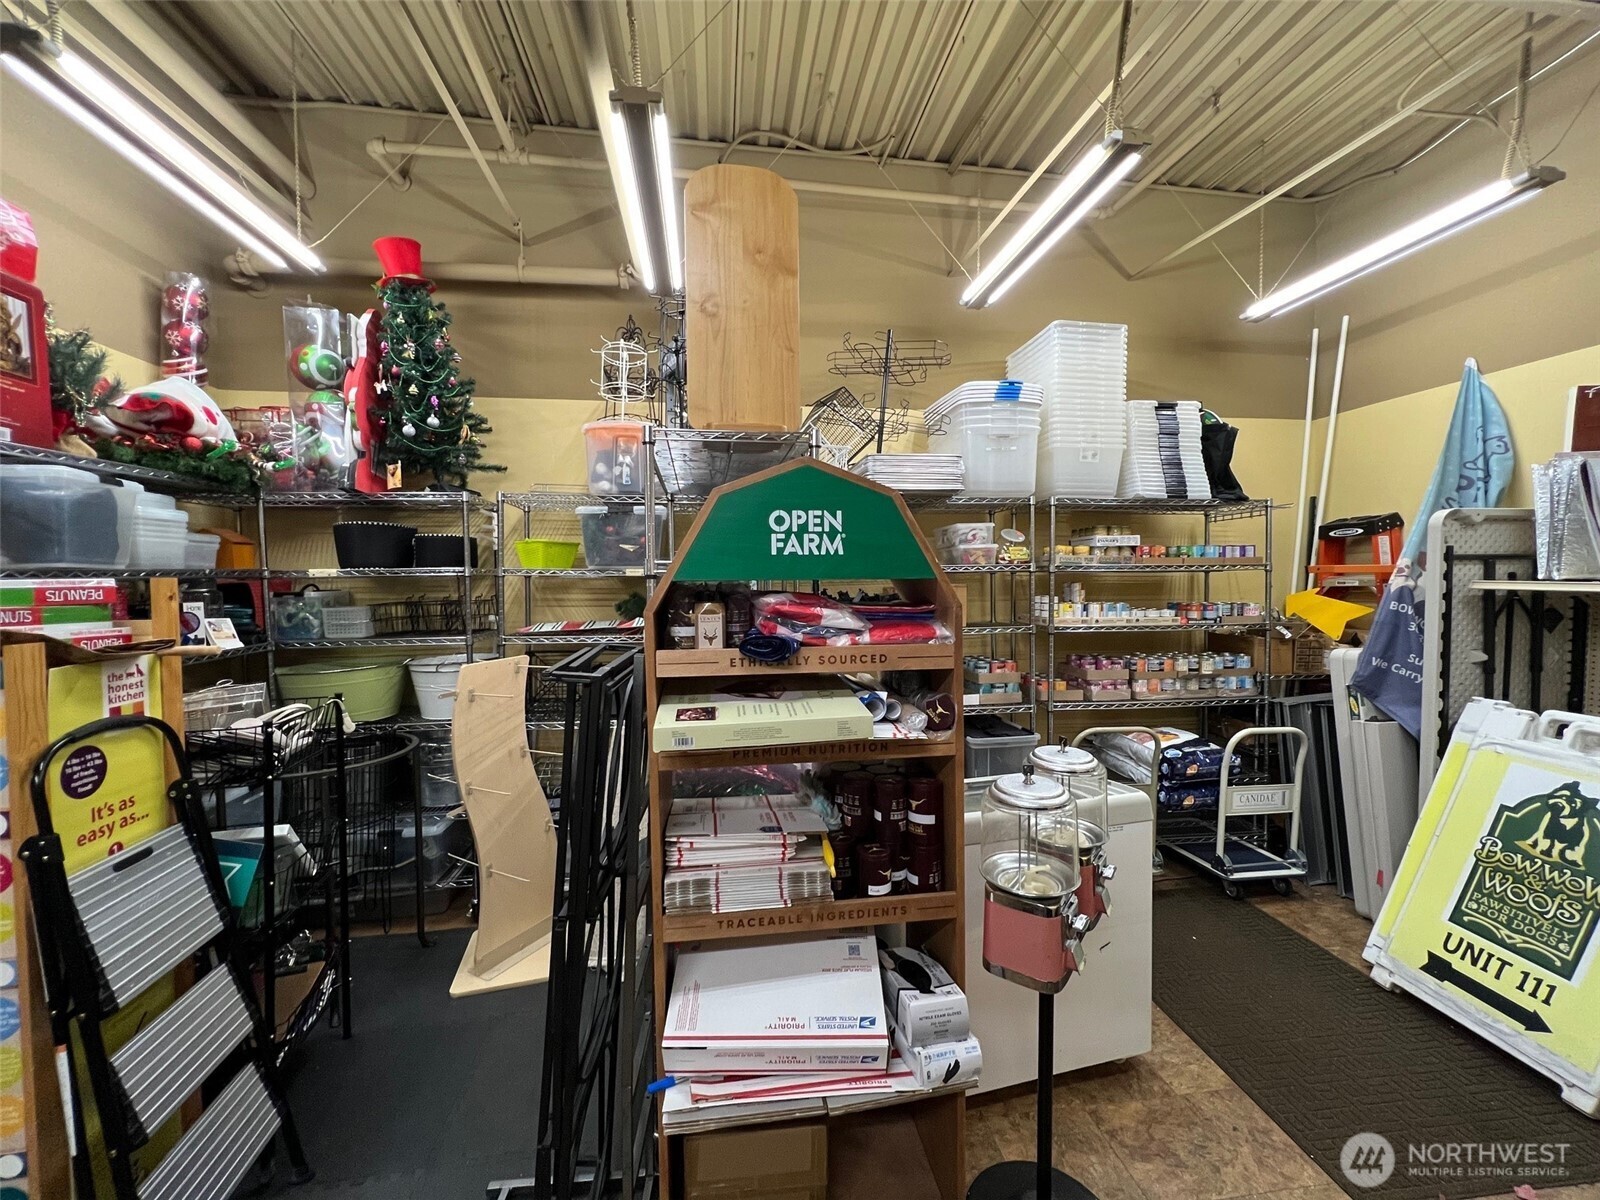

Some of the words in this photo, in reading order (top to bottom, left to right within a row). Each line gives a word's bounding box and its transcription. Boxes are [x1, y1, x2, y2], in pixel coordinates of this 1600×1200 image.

[768, 509, 843, 532] OPEN
[45, 588, 104, 602] PEANUTS
[818, 653, 889, 666] SOURCED
[107, 672, 124, 683] the
[1391, 662, 1424, 684] Carry
[107, 679, 144, 695] honest
[108, 691, 145, 705] kitchen
[732, 745, 801, 759] PREMIUM
[808, 741, 889, 755] NUTRITION
[1239, 793, 1277, 804] CANIDAE
[91, 802, 116, 823] It's
[118, 796, 136, 812] as
[76, 821, 116, 847] easy
[119, 812, 150, 829] as...
[1524, 873, 1547, 892] &
[716, 913, 804, 930] TRACEABLE
[810, 905, 908, 923] INGREDIENTS
[1472, 891, 1574, 943] PAWSITIVELY
[1478, 904, 1508, 925] FOR
[1511, 919, 1558, 946] DOGS
[1442, 931, 1514, 980] UNIT
[1515, 970, 1558, 1007] 111
